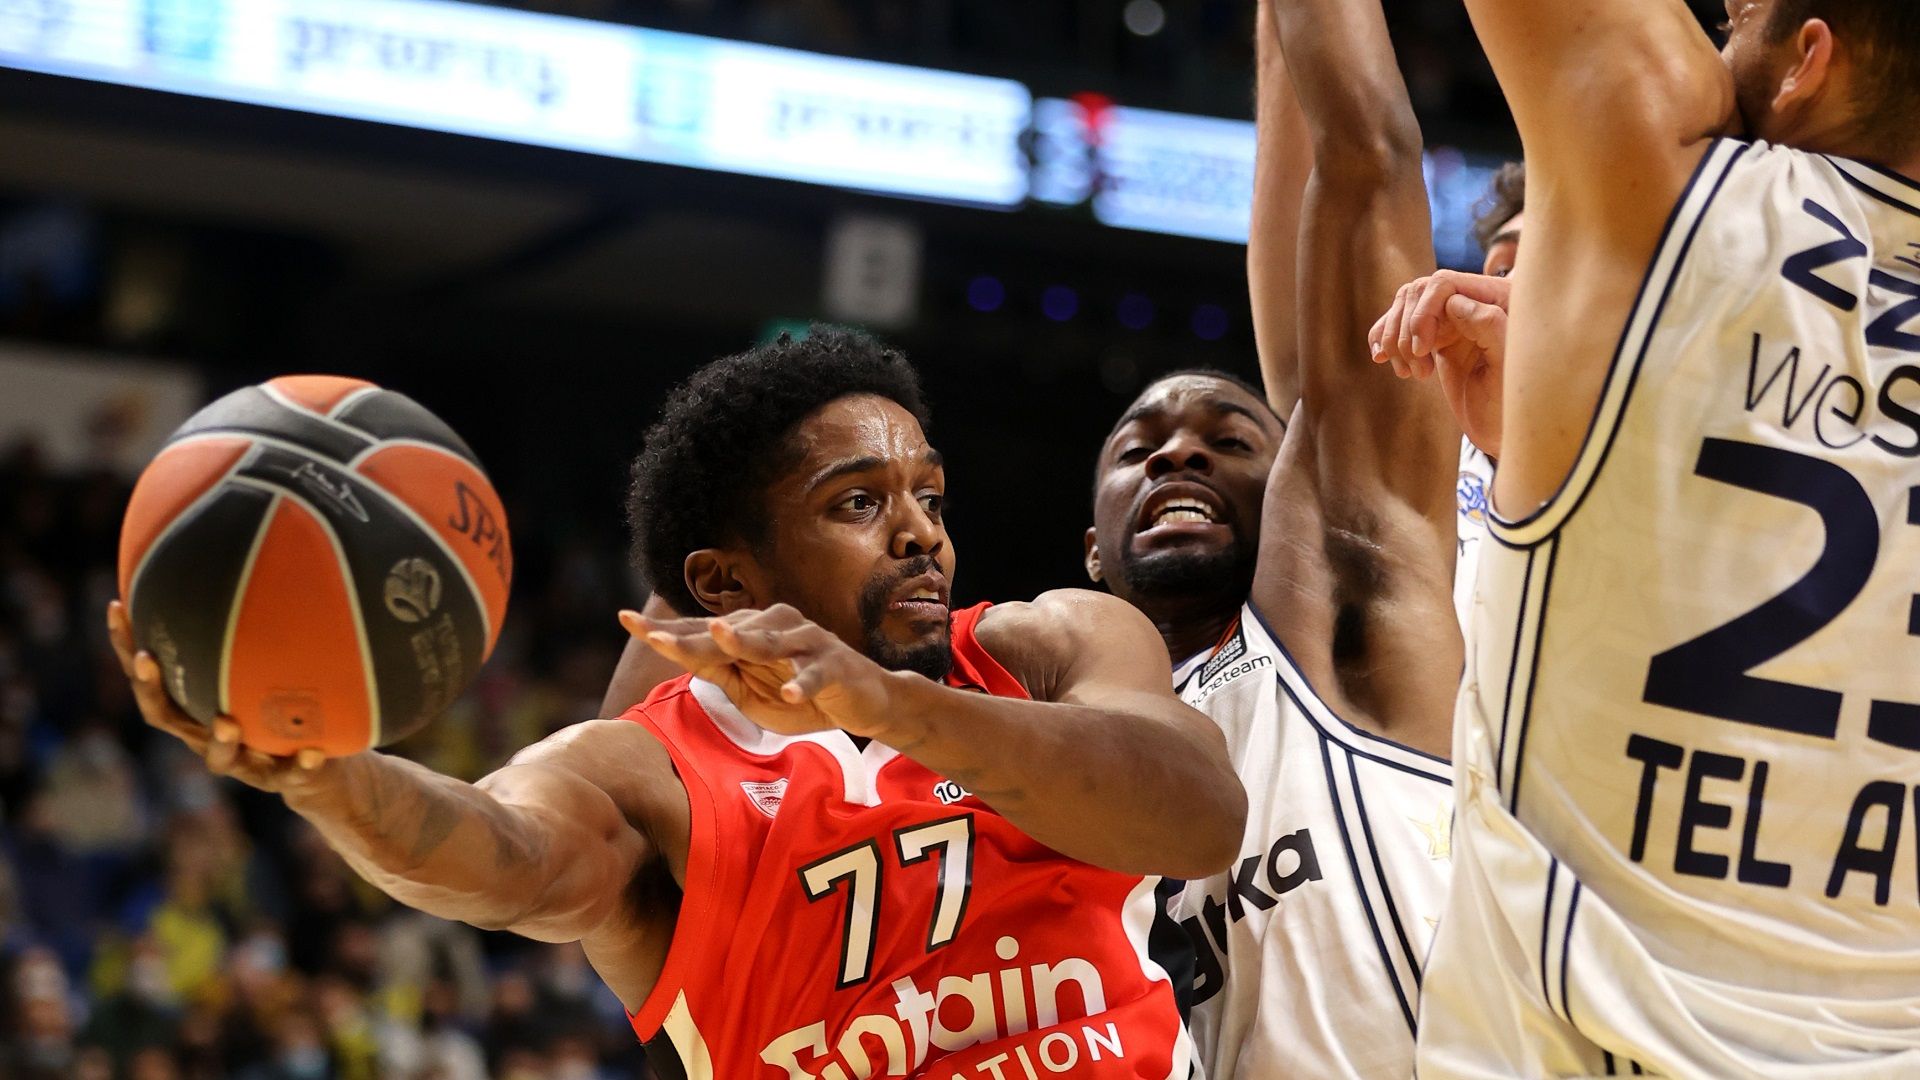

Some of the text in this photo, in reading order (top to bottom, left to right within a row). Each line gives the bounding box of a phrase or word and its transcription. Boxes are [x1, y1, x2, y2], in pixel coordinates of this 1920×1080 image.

[797, 813, 976, 991] 77
[1625, 732, 1920, 907] TEL A
